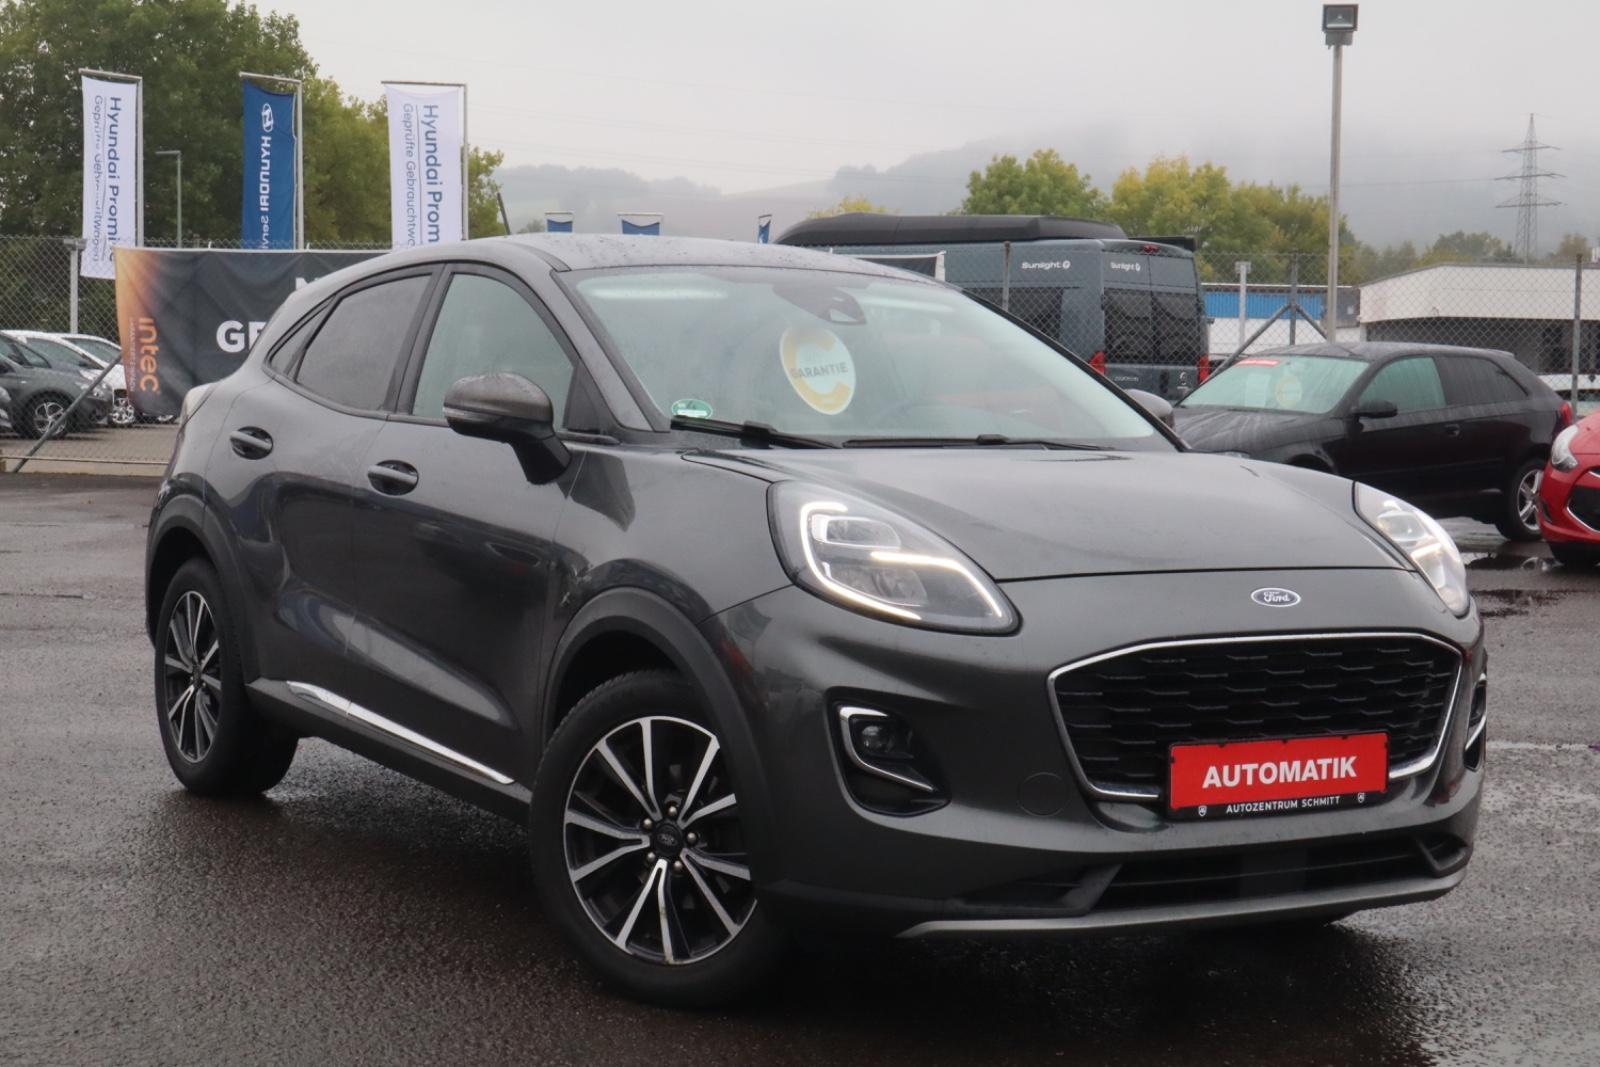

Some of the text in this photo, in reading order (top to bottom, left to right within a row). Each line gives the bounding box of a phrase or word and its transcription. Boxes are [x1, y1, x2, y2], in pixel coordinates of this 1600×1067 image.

[402, 103, 416, 158] Geprüfte
[421, 104, 443, 185] Hyundai
[106, 96, 122, 262] Hyundai Promi
[1021, 261, 1062, 271] Sunlight
[790, 361, 849, 379] GARANTIE
[1263, 591, 1291, 603] Ford
[1202, 756, 1358, 789] AUTOMATIK
[1225, 799, 1298, 814] AUTOZENTRUM
[1301, 795, 1341, 809] SCHMITT
